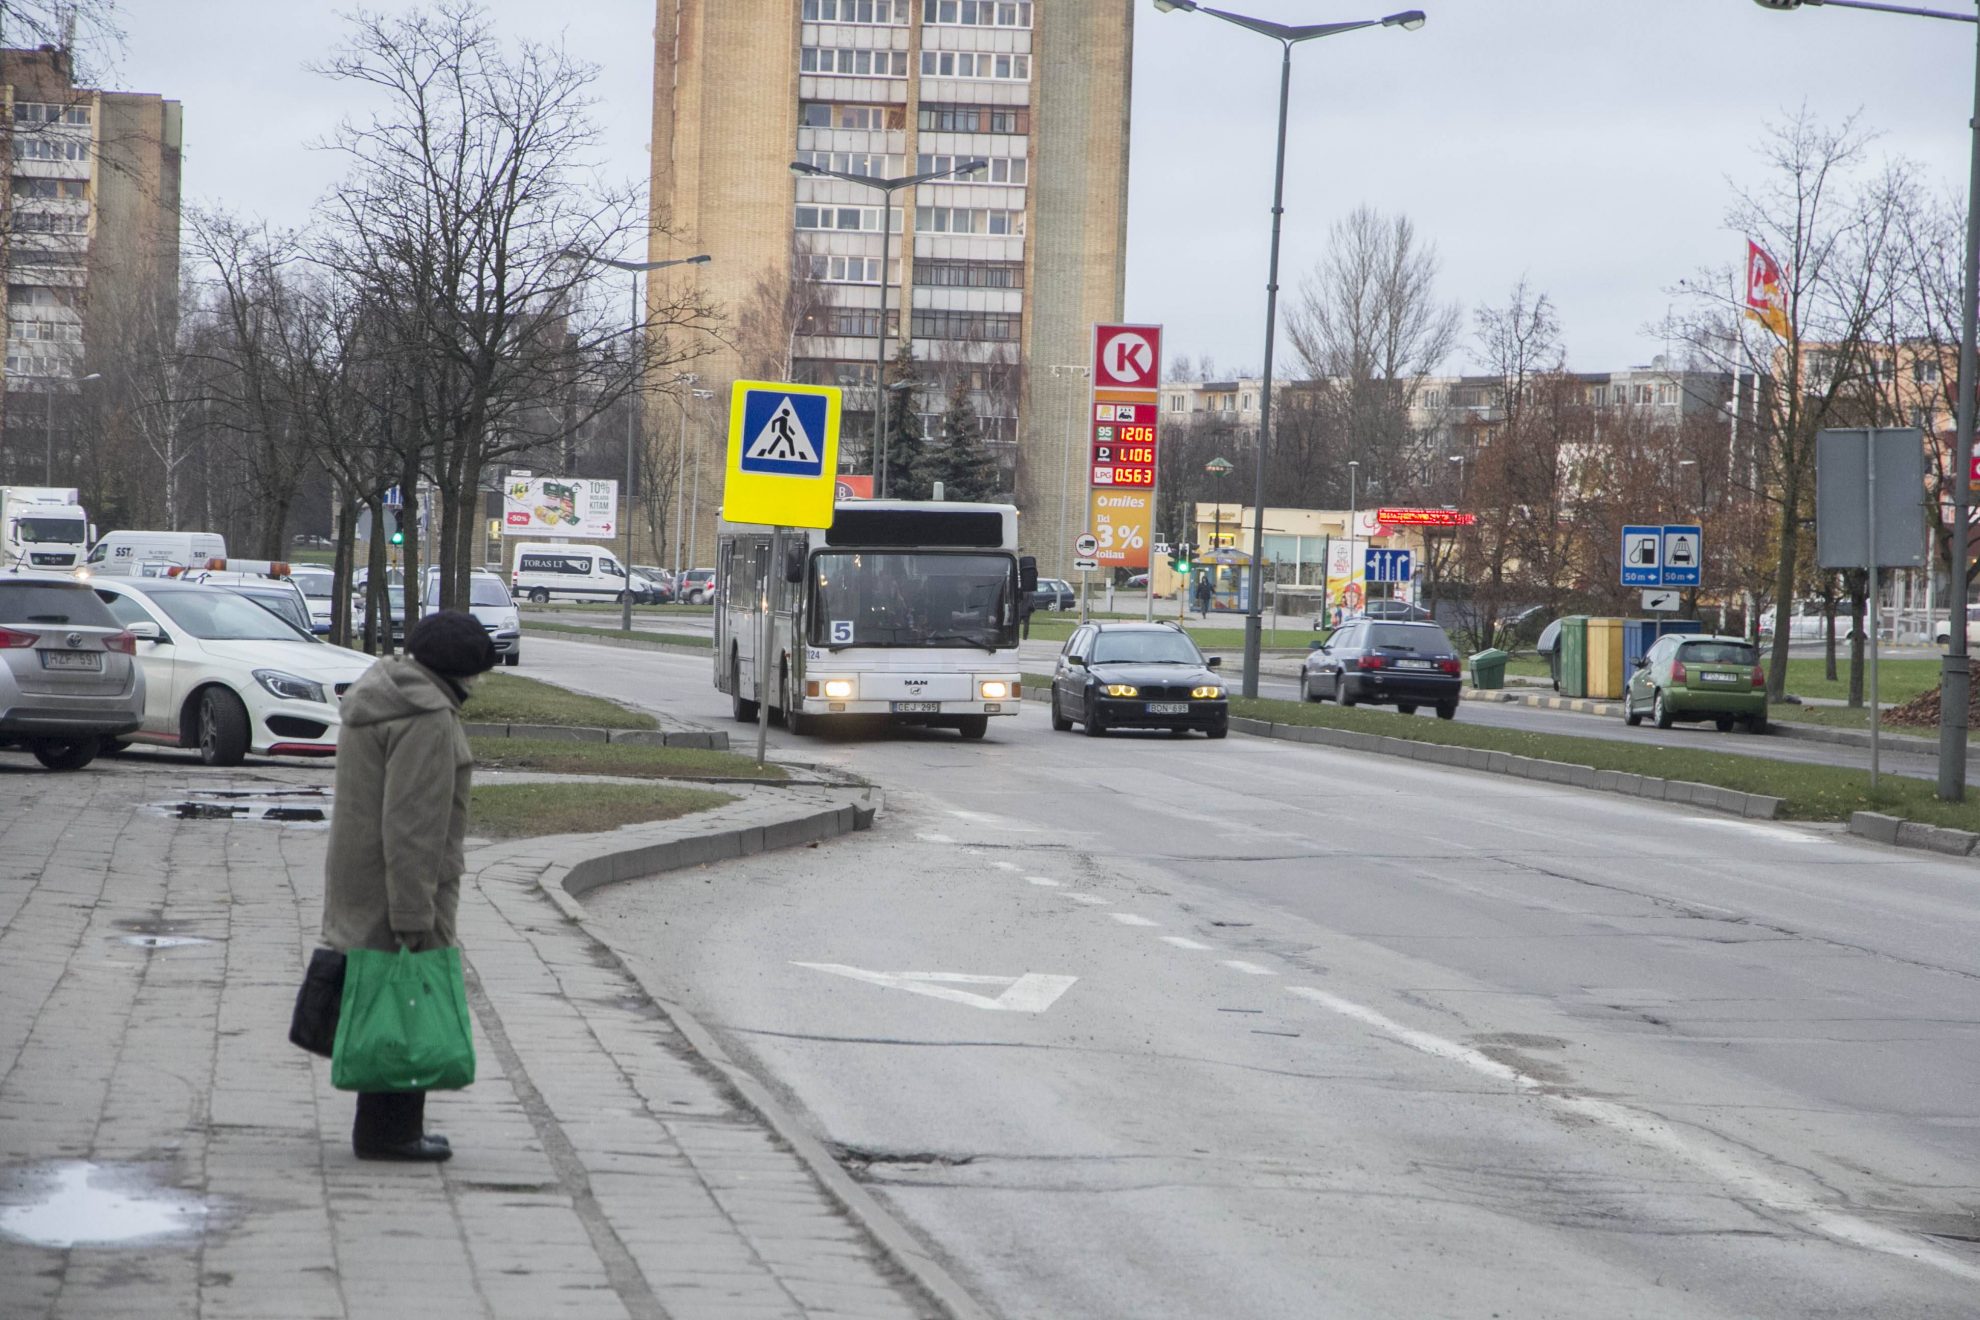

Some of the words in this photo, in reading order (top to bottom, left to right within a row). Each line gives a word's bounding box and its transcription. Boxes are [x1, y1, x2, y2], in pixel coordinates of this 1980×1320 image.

[1098, 427, 1112, 436] 95
[1099, 447, 1110, 457] D
[1119, 448, 1152, 463] 1.106
[1095, 471, 1112, 479] LPG
[1115, 468, 1152, 483] 0.563
[590, 481, 611, 494] 10%
[1108, 496, 1145, 508] miles
[523, 559, 552, 568] TORAS
[553, 560, 564, 568] LT
[1625, 572, 1637, 580] 50
[1664, 572, 1677, 580] 50
[834, 622, 851, 641] 5
